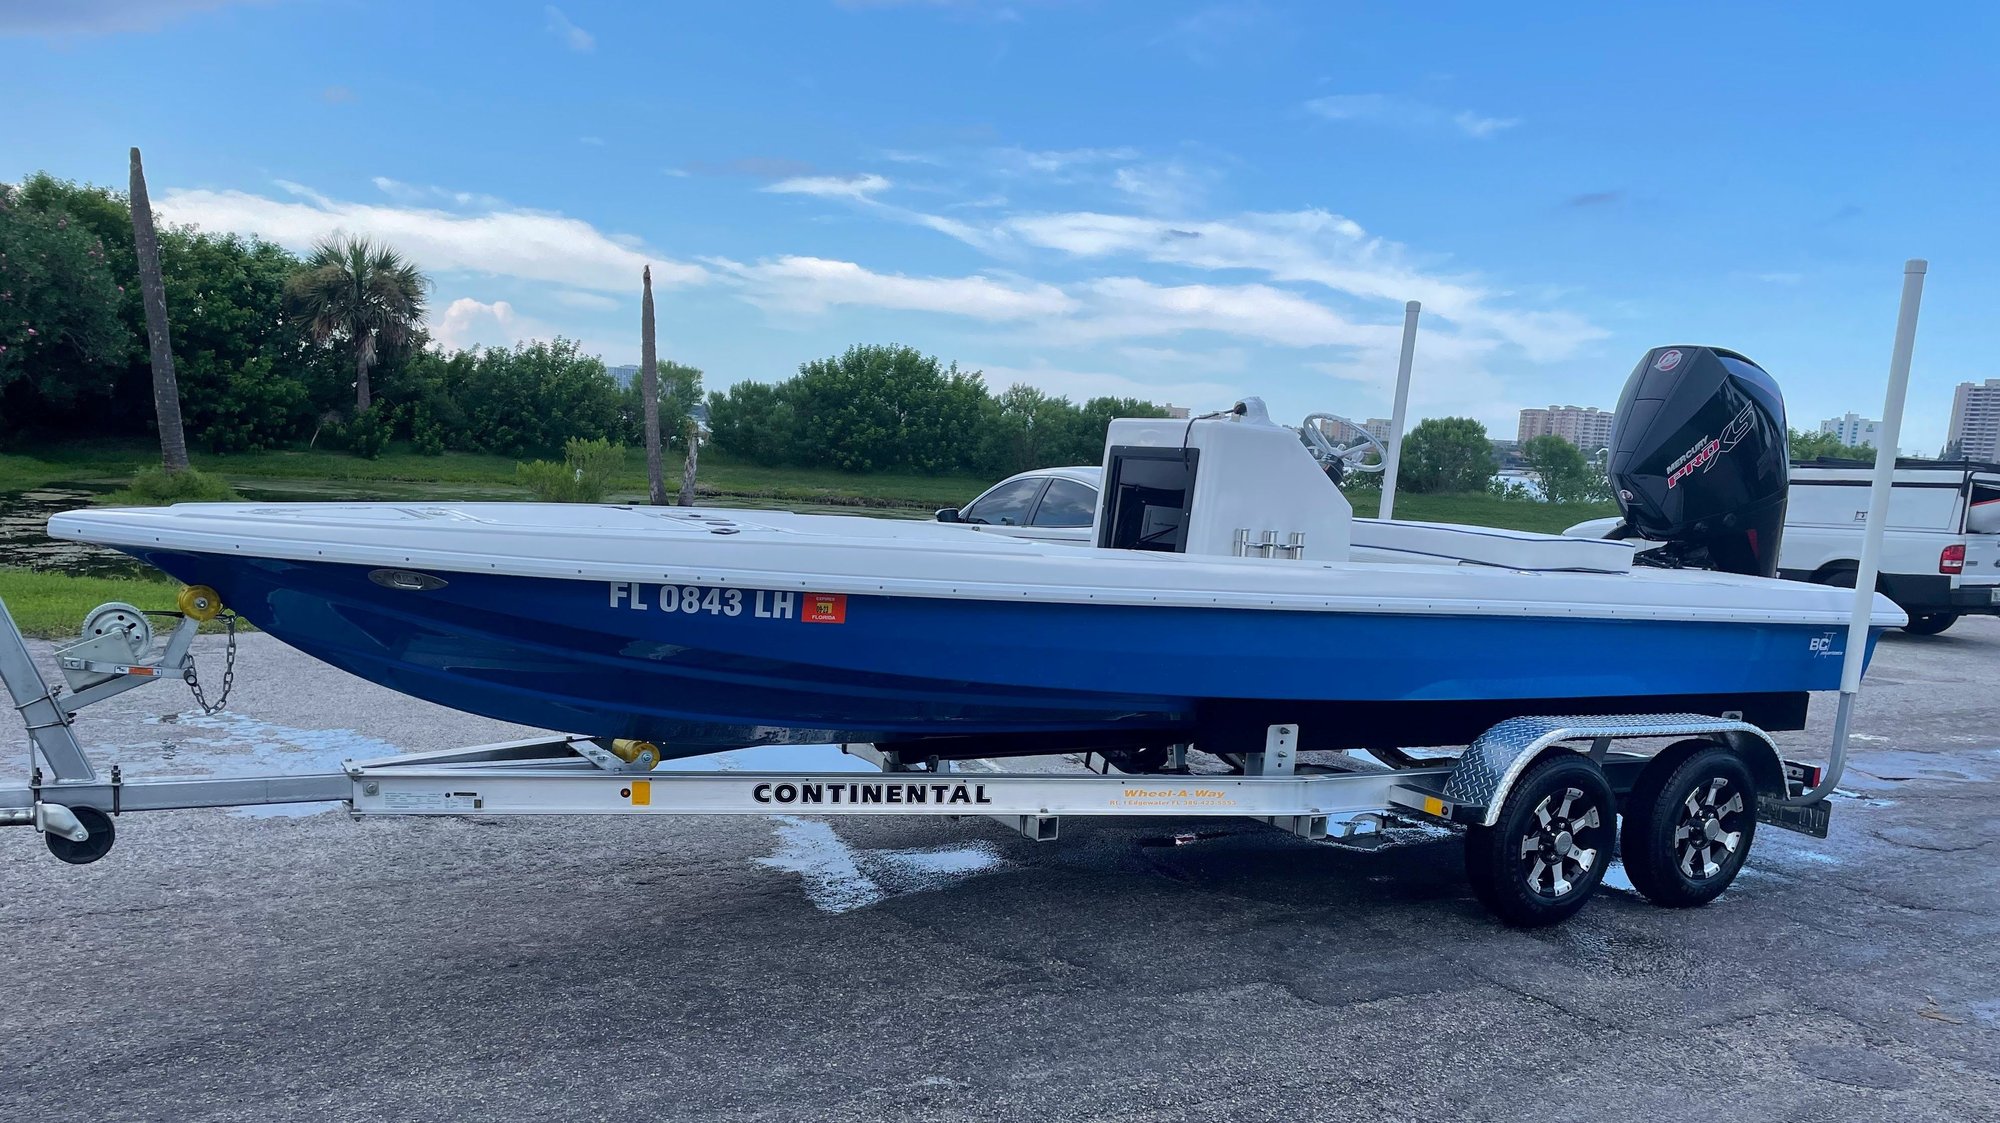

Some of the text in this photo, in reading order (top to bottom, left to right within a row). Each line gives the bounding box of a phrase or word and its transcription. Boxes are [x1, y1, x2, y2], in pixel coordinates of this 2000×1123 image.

[1666, 434, 1709, 474] MERCURY
[1667, 400, 1755, 489] PRO XS
[609, 581, 795, 619] FL 0843 LH
[752, 782, 993, 805] CONTINENTAL
[1124, 789, 1226, 799] Wheel-A-Way
